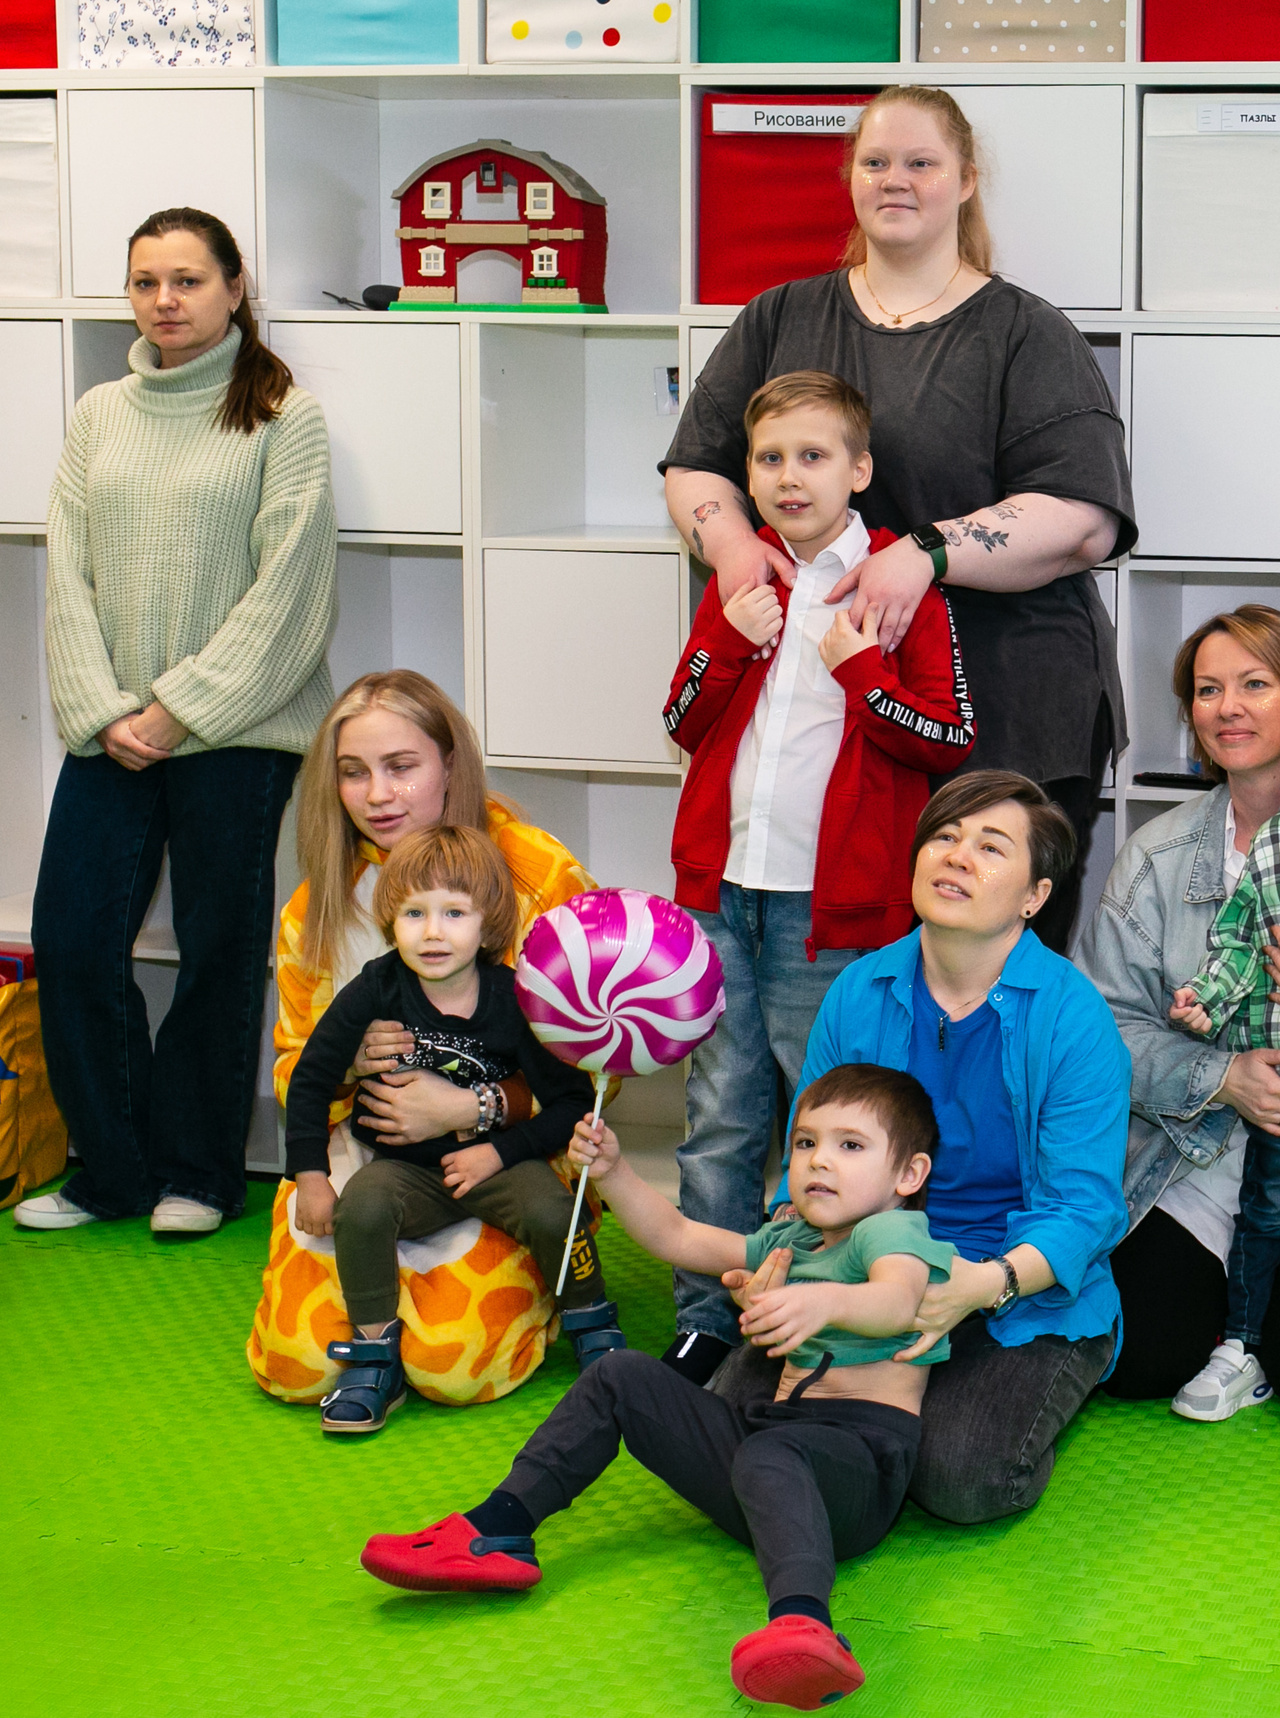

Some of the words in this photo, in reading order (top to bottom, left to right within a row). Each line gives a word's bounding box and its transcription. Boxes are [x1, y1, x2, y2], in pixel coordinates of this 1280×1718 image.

[754, 111, 846, 127] Рисование
[1240, 114, 1277, 123] ПАЗЛЫ
[953, 648, 968, 700] UTILITY
